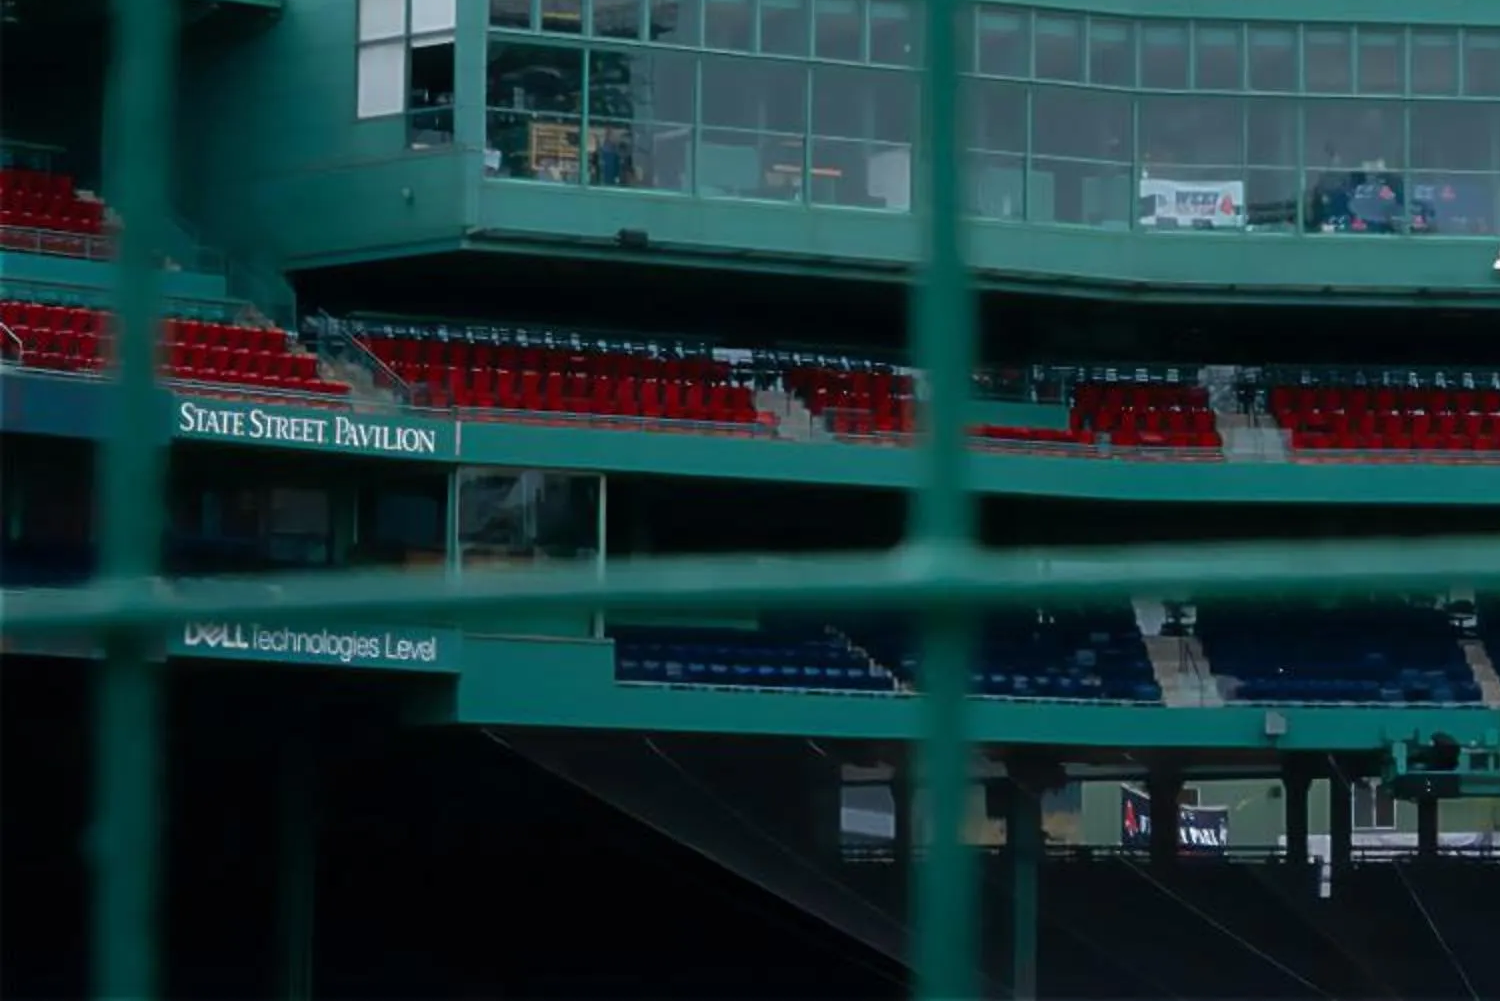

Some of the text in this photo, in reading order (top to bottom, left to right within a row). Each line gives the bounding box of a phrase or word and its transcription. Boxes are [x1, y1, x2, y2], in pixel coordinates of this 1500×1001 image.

[180, 402, 436, 452] STATE STREET PAVILION
[184, 623, 436, 662] DELL Technologies Level
